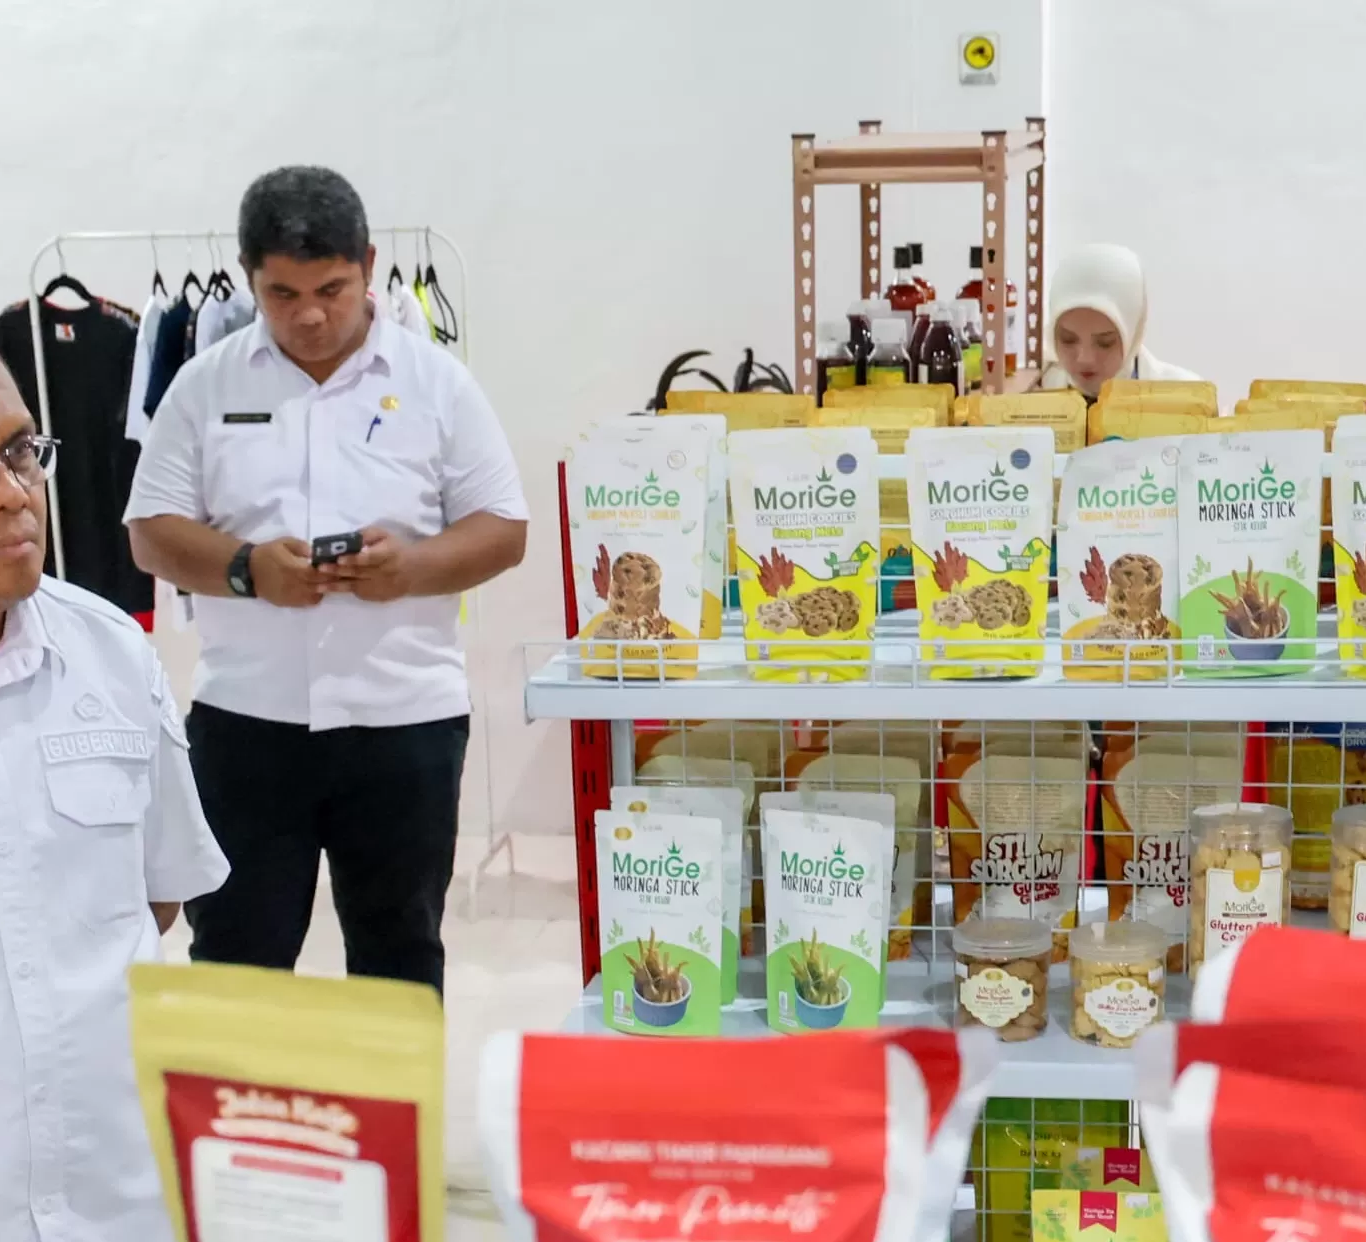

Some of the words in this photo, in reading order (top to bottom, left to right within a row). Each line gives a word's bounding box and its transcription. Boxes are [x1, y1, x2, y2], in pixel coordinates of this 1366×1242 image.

[585, 484, 680, 507] MoriGe
[754, 484, 856, 510] MoriGe
[927, 478, 1029, 504] MoriGe
[1078, 483, 1176, 508] MoriGe
[1198, 476, 1296, 503] MoriGe
[1199, 502, 1254, 522] MORINGA
[1261, 500, 1296, 520] STICK
[48, 730, 145, 757] GUBERNUR
[612, 851, 700, 879] MoriGe
[781, 851, 865, 881] MoriGe
[613, 874, 660, 893] MORINGA
[666, 879, 700, 896] STICK
[781, 874, 823, 894] MORINGA
[829, 880, 863, 898] STICK
[1225, 900, 1265, 912] MoriGe
[1209, 920, 1253, 931] Glutten
